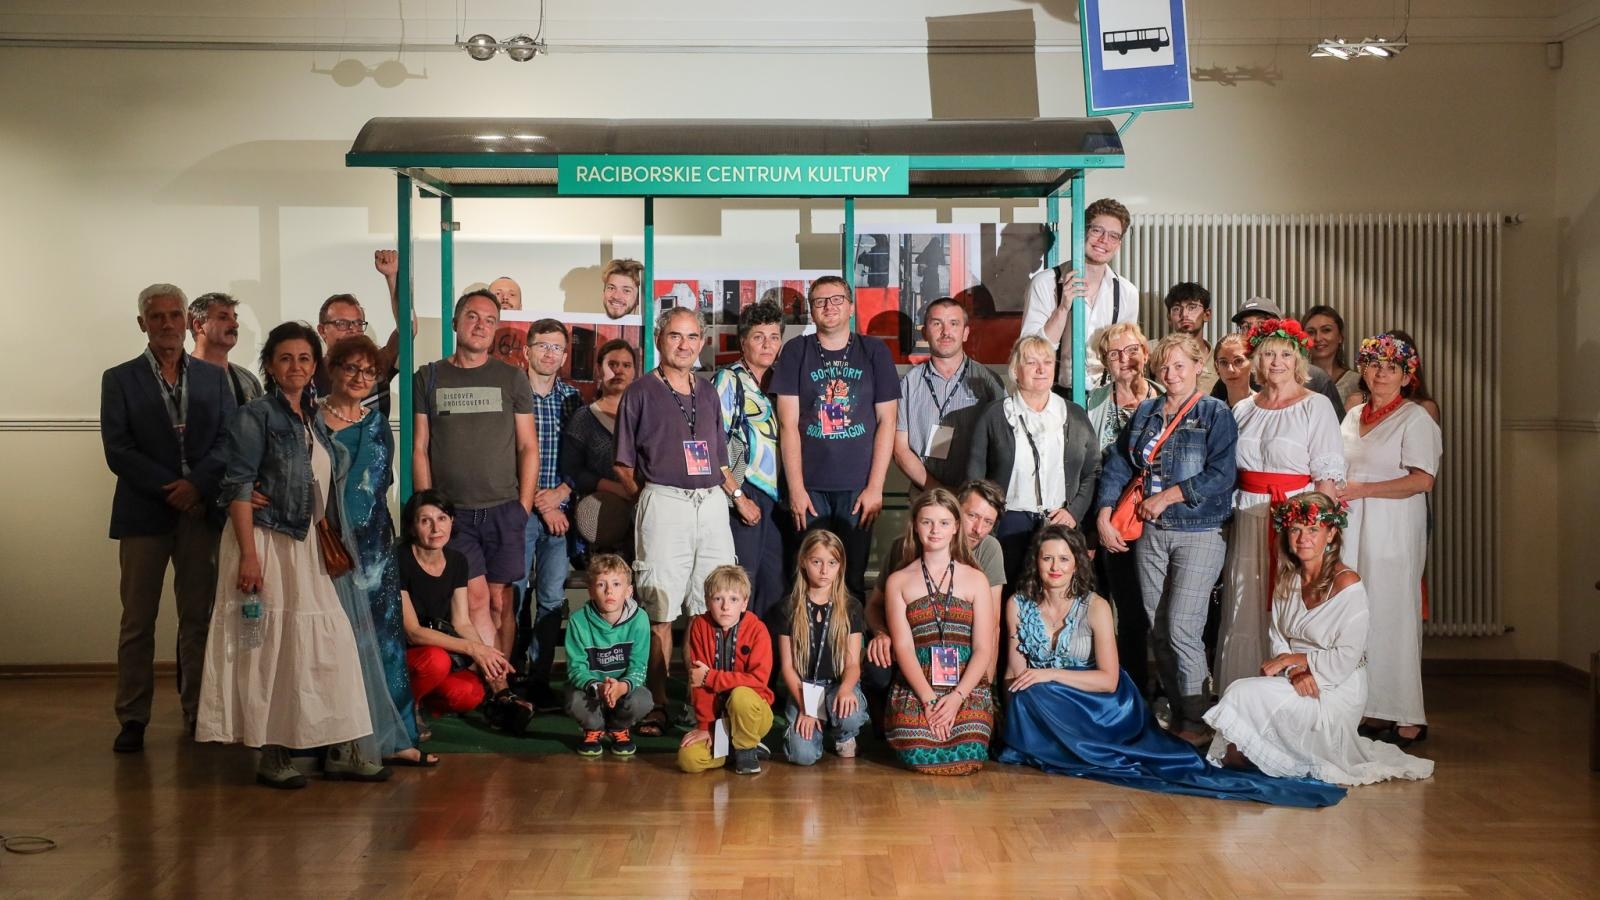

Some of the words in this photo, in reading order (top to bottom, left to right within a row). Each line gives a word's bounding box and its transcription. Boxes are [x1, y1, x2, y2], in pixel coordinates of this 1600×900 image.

[576, 165, 702, 183] RACIBORSKIE
[706, 165, 801, 183] CENTRUM
[807, 165, 891, 183] KULTURY
